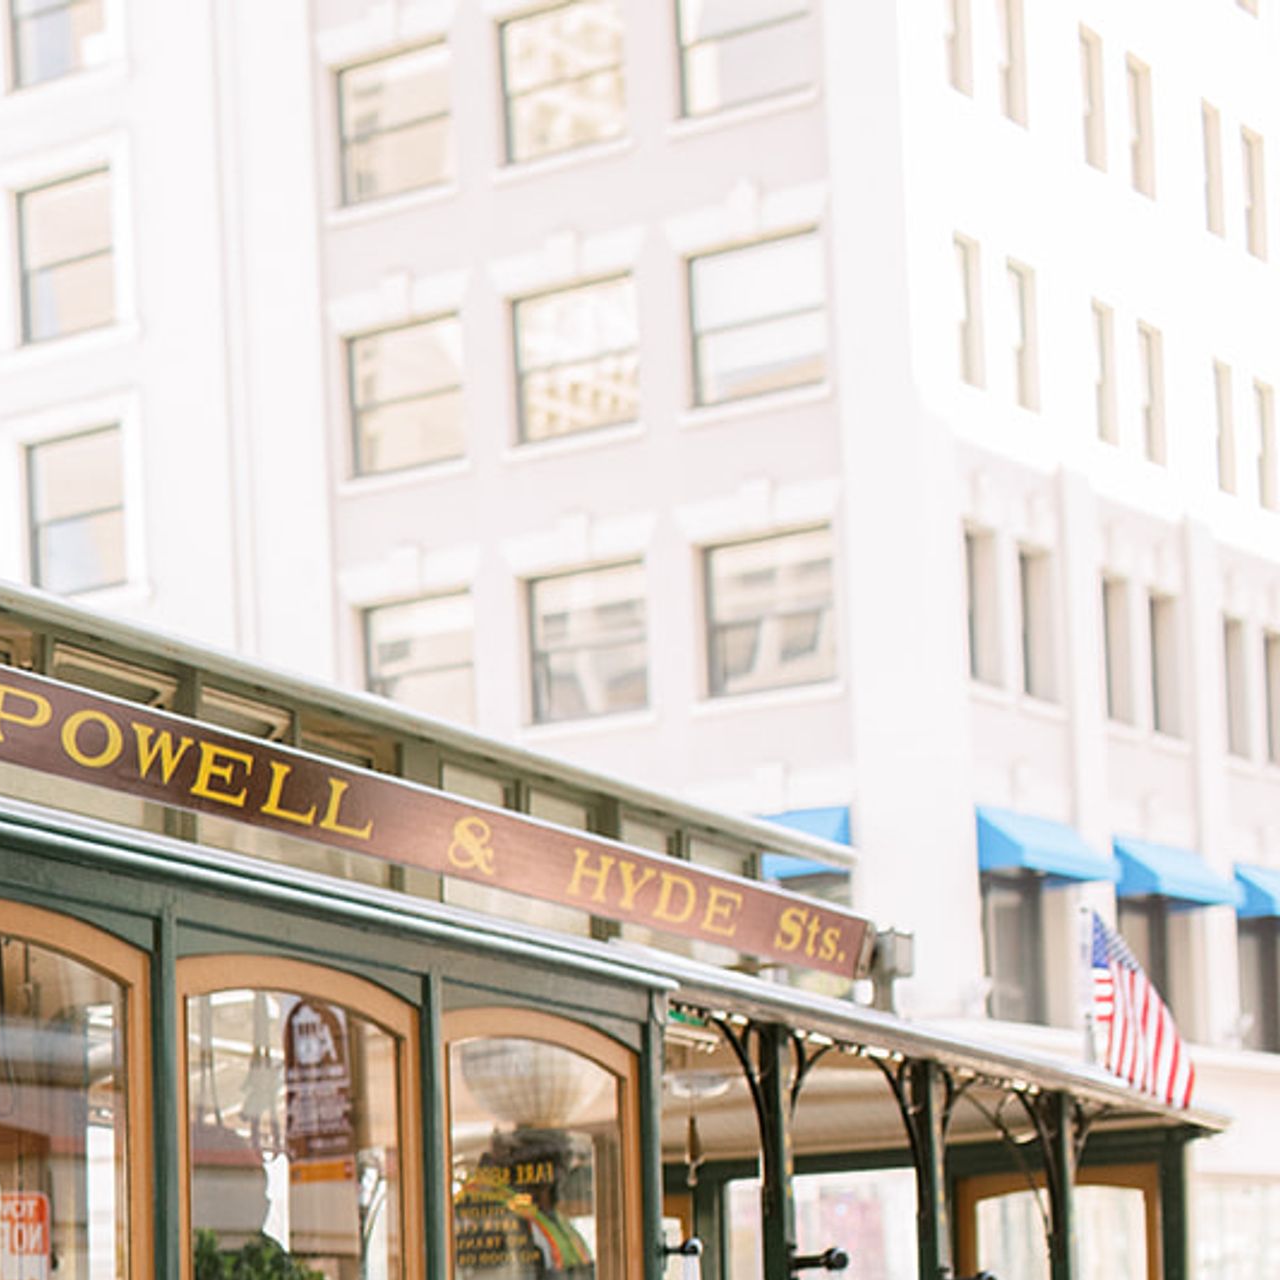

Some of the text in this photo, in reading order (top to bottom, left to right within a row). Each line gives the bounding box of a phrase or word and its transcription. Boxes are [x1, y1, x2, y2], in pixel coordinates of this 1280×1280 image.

[447, 815, 495, 876] &
[566, 846, 744, 938] HYDE
[773, 905, 848, 964] Sts.
